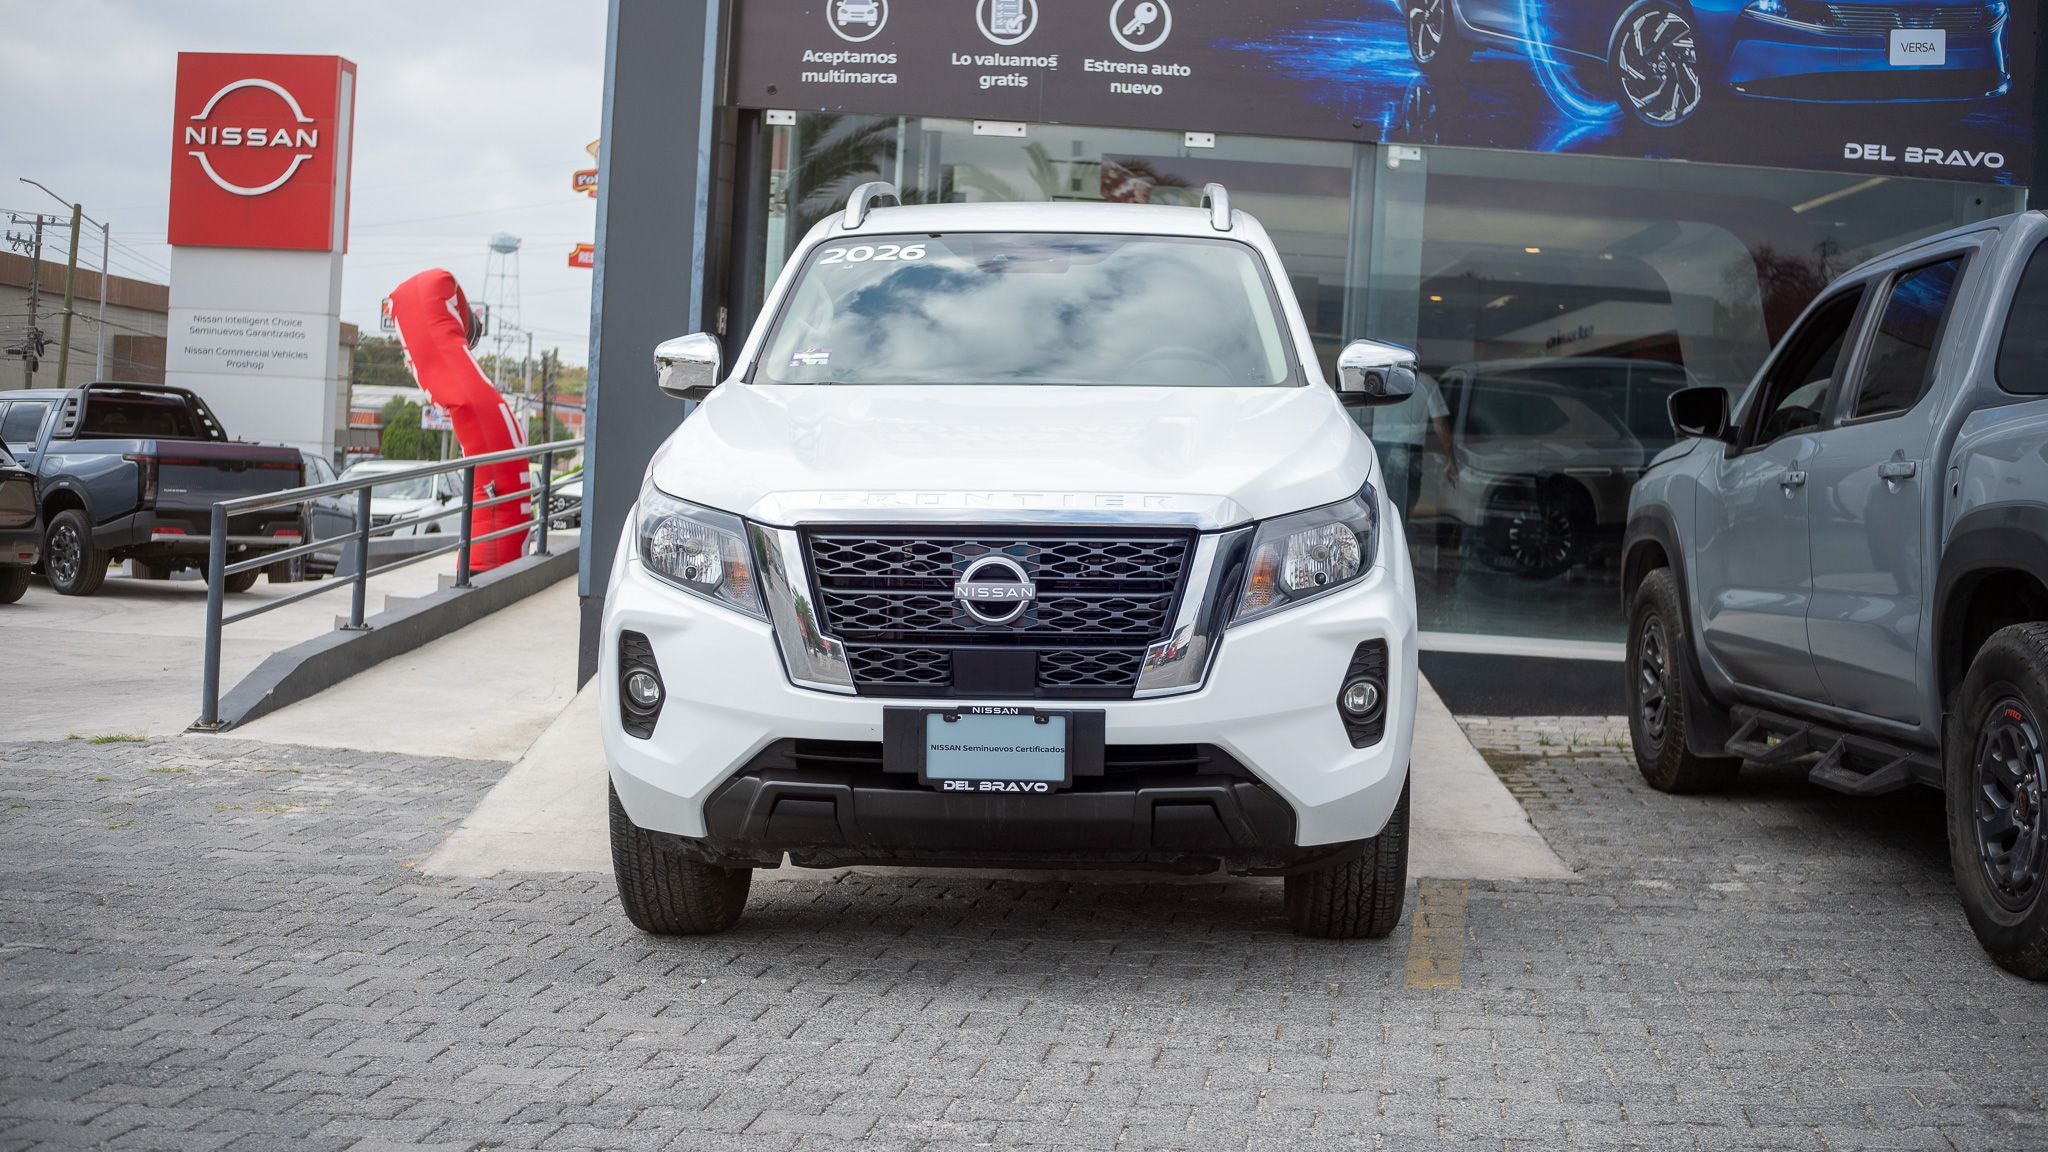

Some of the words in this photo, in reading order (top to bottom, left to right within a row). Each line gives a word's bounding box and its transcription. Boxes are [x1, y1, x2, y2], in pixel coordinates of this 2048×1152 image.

[1900, 42, 1936, 53] VERSA
[801, 49, 898, 66] Aceptamos
[951, 52, 972, 66] Lo
[974, 53, 1058, 68] valuamos
[1083, 58, 1148, 75] Estrena
[1151, 61, 1191, 77] auto
[801, 69, 898, 85] multimarca
[979, 72, 1029, 89] gratis
[1109, 80, 1163, 96] nuevo
[185, 126, 318, 148] NISSAN
[1844, 142, 1896, 162] DEL
[1904, 146, 2005, 169] BRAVO
[819, 244, 926, 265] 2026
[193, 315, 223, 324] Nissan
[225, 315, 269, 326] Intelligent
[271, 317, 303, 327] Choice
[189, 326, 244, 336] Seminuevos
[245, 328, 306, 339] Garantizados
[184, 346, 214, 355] Nissan
[215, 347, 270, 357] Commercial
[272, 349, 309, 359] Vehicles
[226, 359, 265, 370] Proshop
[818, 492, 1175, 509] FRONTIER
[957, 587, 1034, 598] NISSAN
[971, 706, 1019, 715] NISSAN
[930, 744, 961, 752] NISSAN
[962, 744, 1014, 753] Seminuevos
[1015, 745, 1065, 754] Certificados
[943, 780, 975, 792] DEL
[979, 781, 1049, 793] BRAVO
